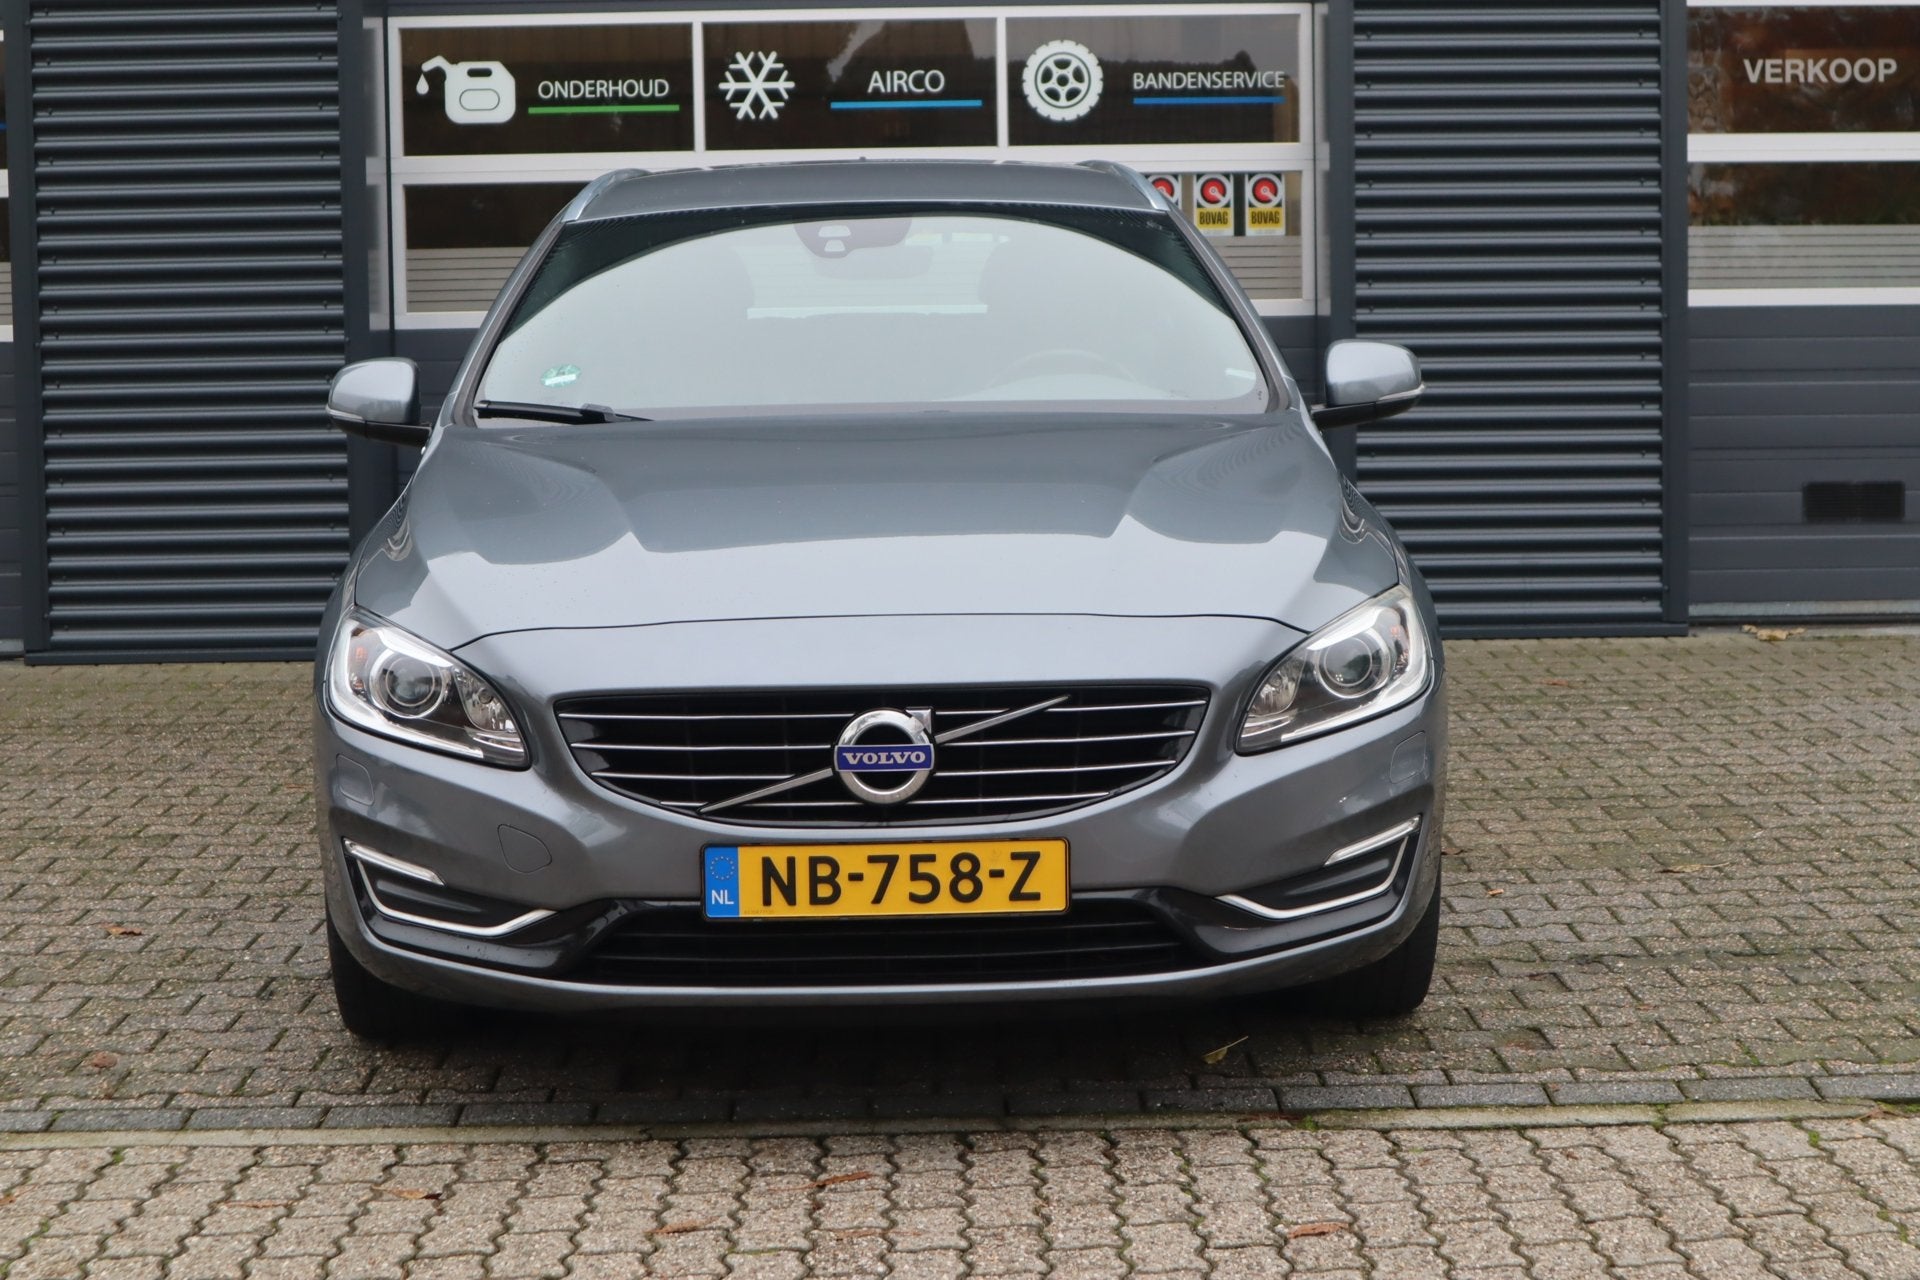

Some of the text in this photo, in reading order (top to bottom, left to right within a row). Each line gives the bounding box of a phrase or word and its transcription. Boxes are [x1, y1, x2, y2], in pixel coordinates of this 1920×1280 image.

[1132, 70, 1286, 89] BANDENSERVICE
[1743, 57, 1898, 84] VERKOOP
[537, 78, 669, 98] ONDERHOUD
[867, 69, 945, 93] AIRCO
[1199, 211, 1229, 225] BOVAG
[1251, 210, 1280, 224] BOVAG
[842, 750, 926, 765] VOLVO
[761, 850, 1042, 907] NB-758-Z
[711, 889, 734, 905] NL
